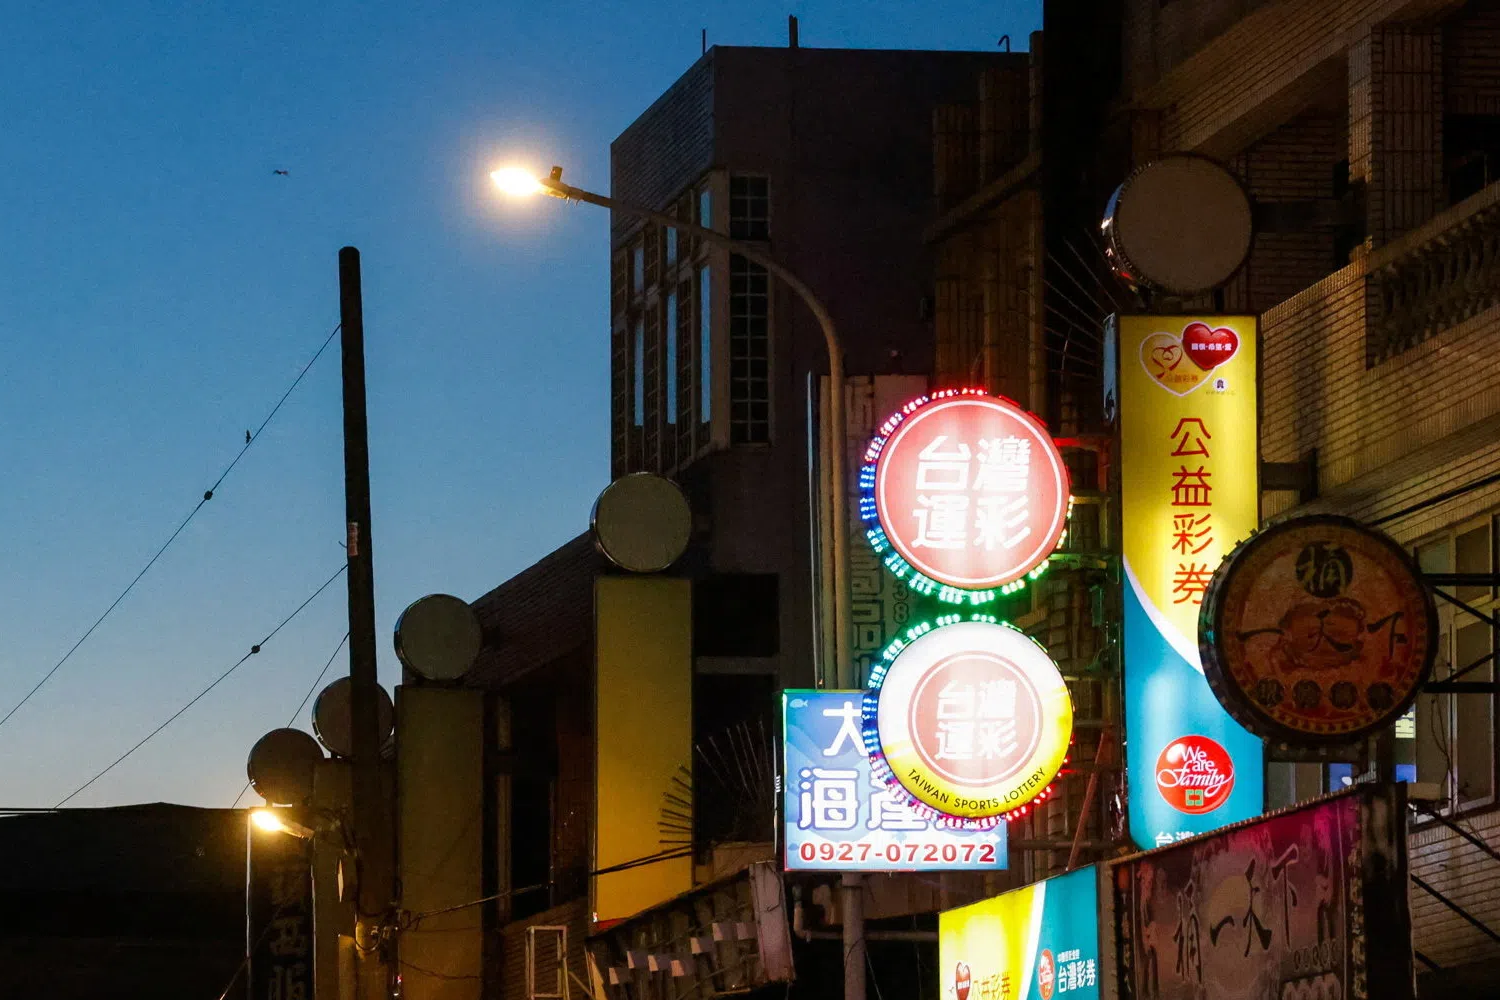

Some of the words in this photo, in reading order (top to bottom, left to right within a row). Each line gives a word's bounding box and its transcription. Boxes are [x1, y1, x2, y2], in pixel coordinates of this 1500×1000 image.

[915, 435, 1032, 492] 台灣
[911, 493, 1032, 551] 運彩
[1170, 417, 1213, 605] 公益彩券
[936, 679, 1019, 718] 台灣
[935, 719, 1019, 761] 運彩
[1181, 746, 1207, 762] We
[907, 768, 950, 804] TAIWAN
[954, 797, 999, 811] SPORTS
[1004, 768, 1046, 803] LOTTERY
[1157, 764, 1234, 798] Family
[799, 841, 996, 863] 0927-072072
[1058, 958, 1096, 993] 台灣彩券
